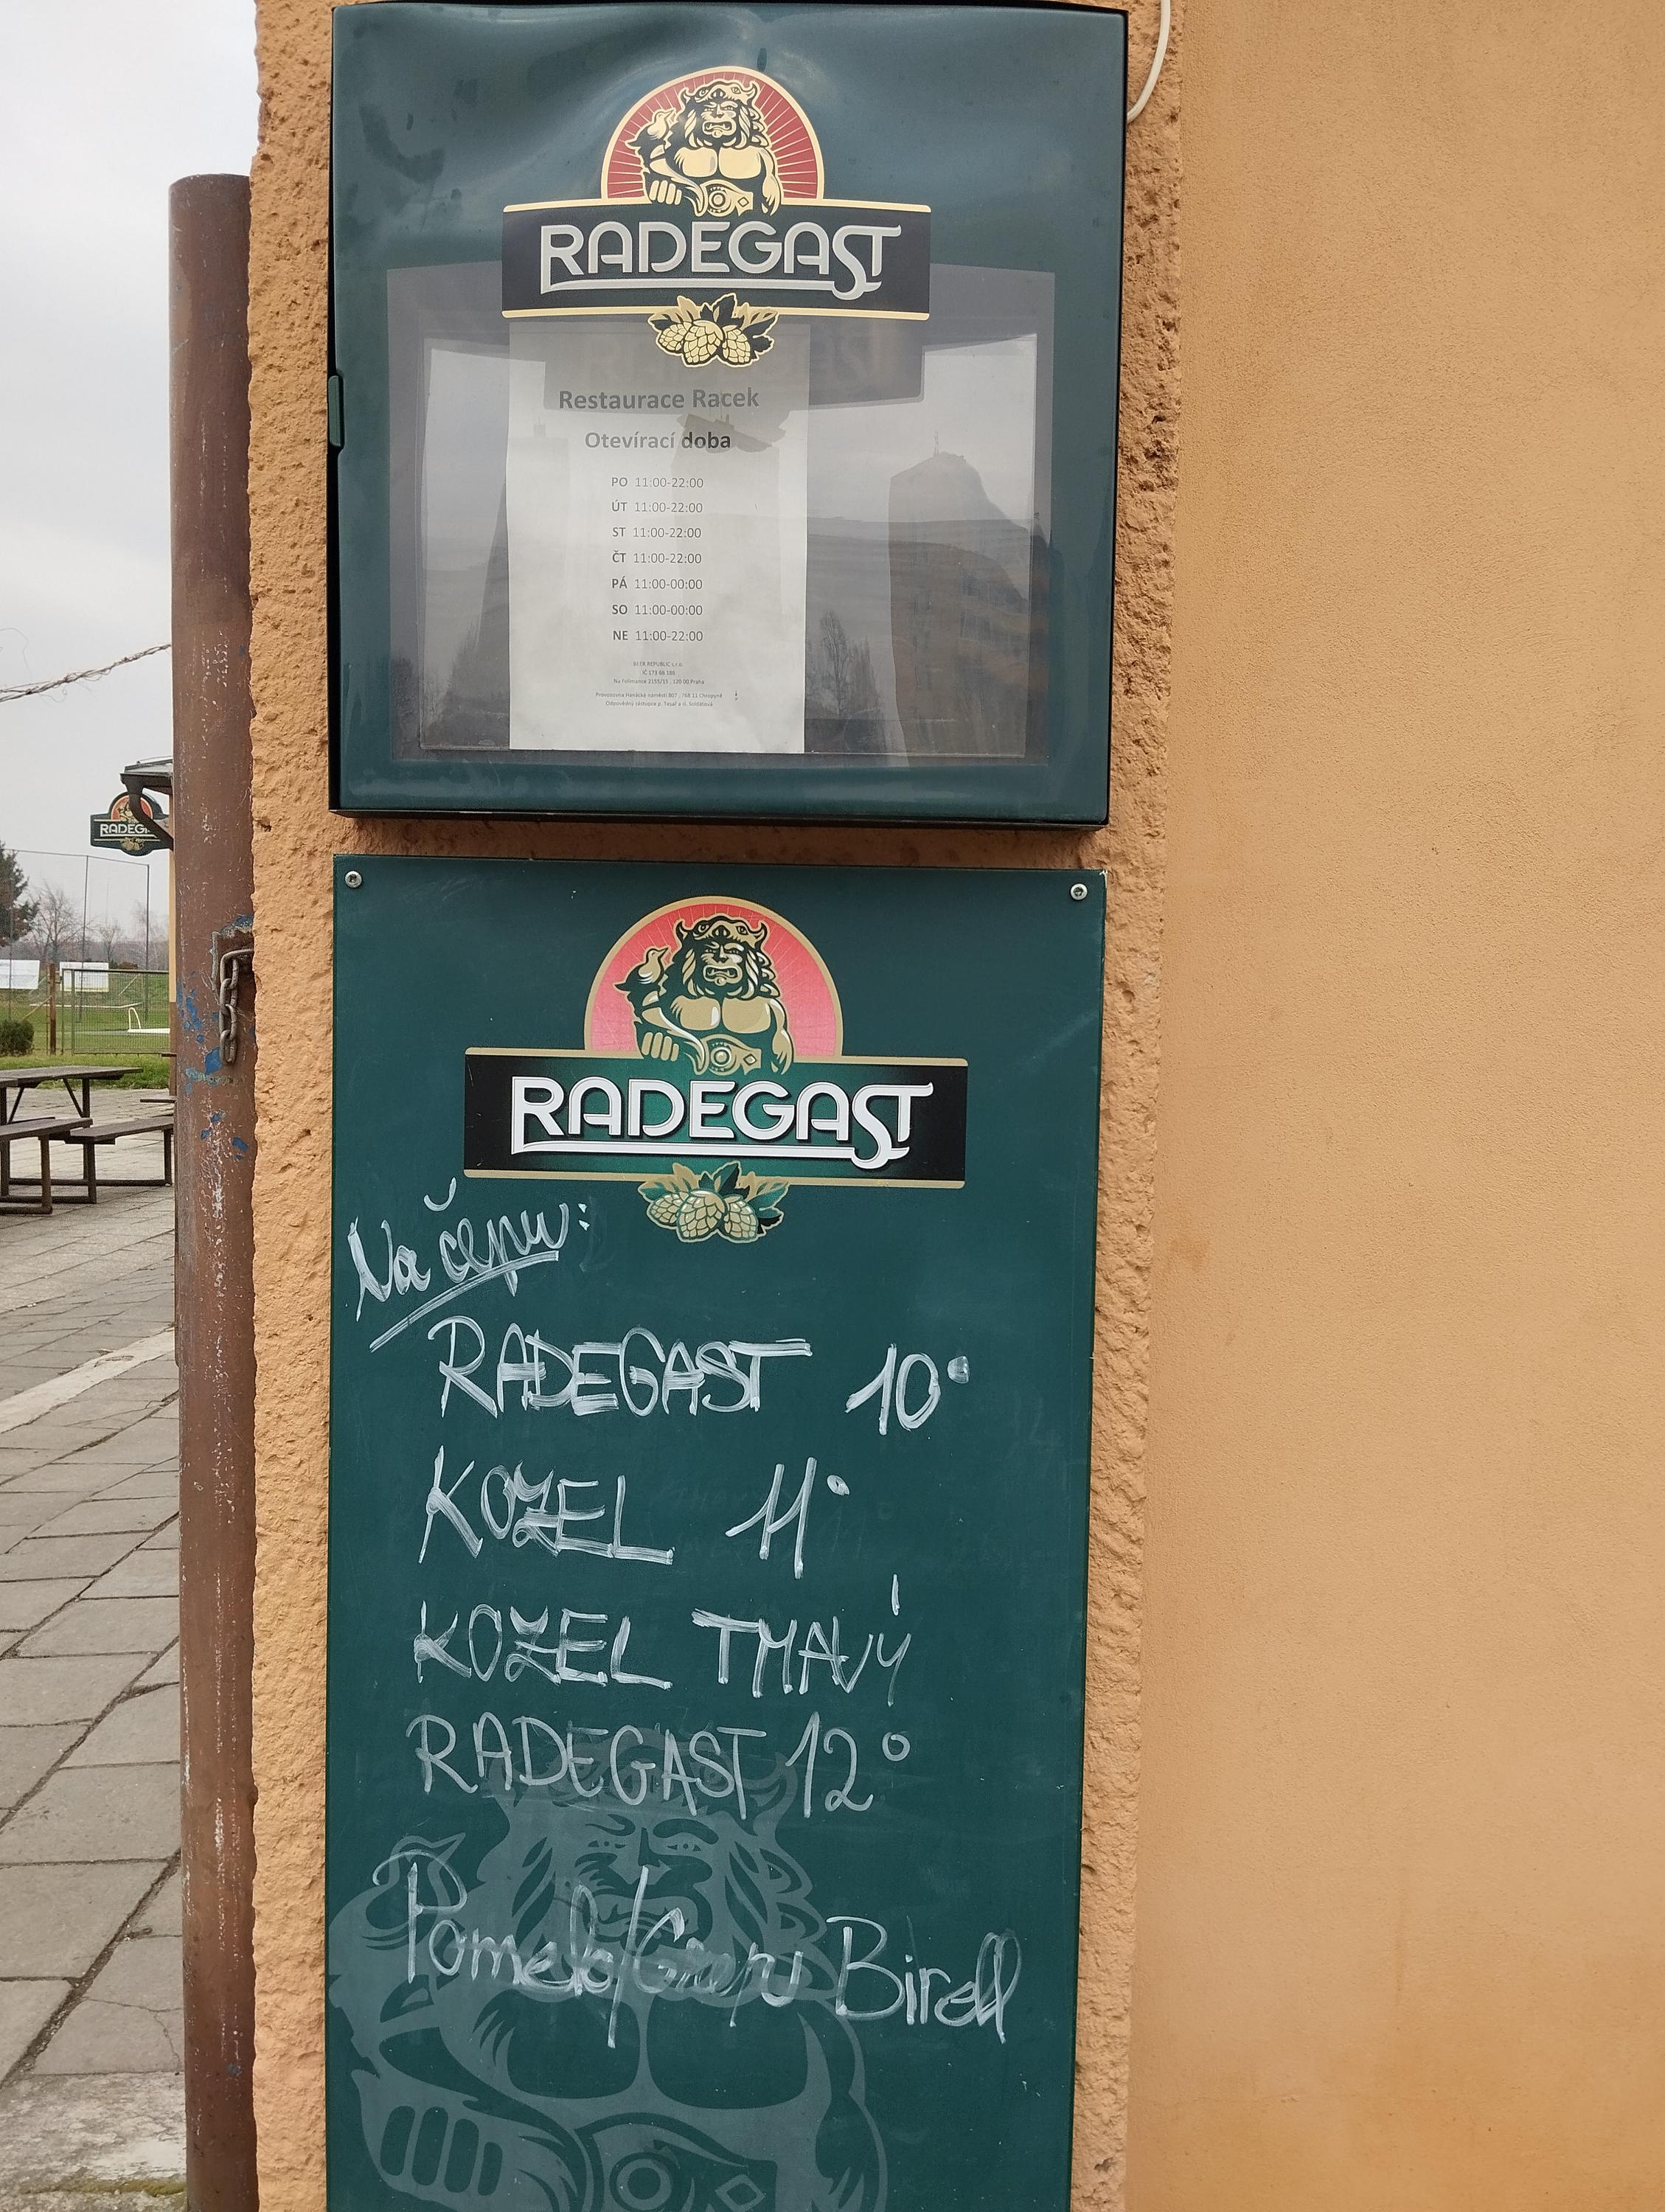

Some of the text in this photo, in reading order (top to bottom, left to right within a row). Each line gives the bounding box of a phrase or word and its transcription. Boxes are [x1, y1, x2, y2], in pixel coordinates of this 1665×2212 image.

[540, 221, 901, 300] RADEGAST
[559, 387, 759, 409] Restaurace Racek
[585, 431, 731, 449] Otevírací doba
[611, 477, 703, 488] PO 11:00-22:00
[611, 499, 703, 513] ÚT 11:00-22:00
[612, 527, 702, 538] ST 11:00-22:00
[612, 550, 702, 564] ČT 11:00-22:00
[611, 576, 703, 589] PÁ 11:00-00:00
[611, 605, 703, 616] SO 11:00-00:00
[613, 630, 703, 641] NE 11:00-22:00
[100, 824, 158, 839] RADEG
[512, 1077, 934, 1169] RADEGAST
[347, 1217, 431, 1321] Na
[428, 1316, 813, 1417] RADEGAST
[417, 1446, 674, 1565] KOZEL
[413, 1601, 673, 1691] KOZEL
[406, 1711, 767, 1820] RADEGAST
